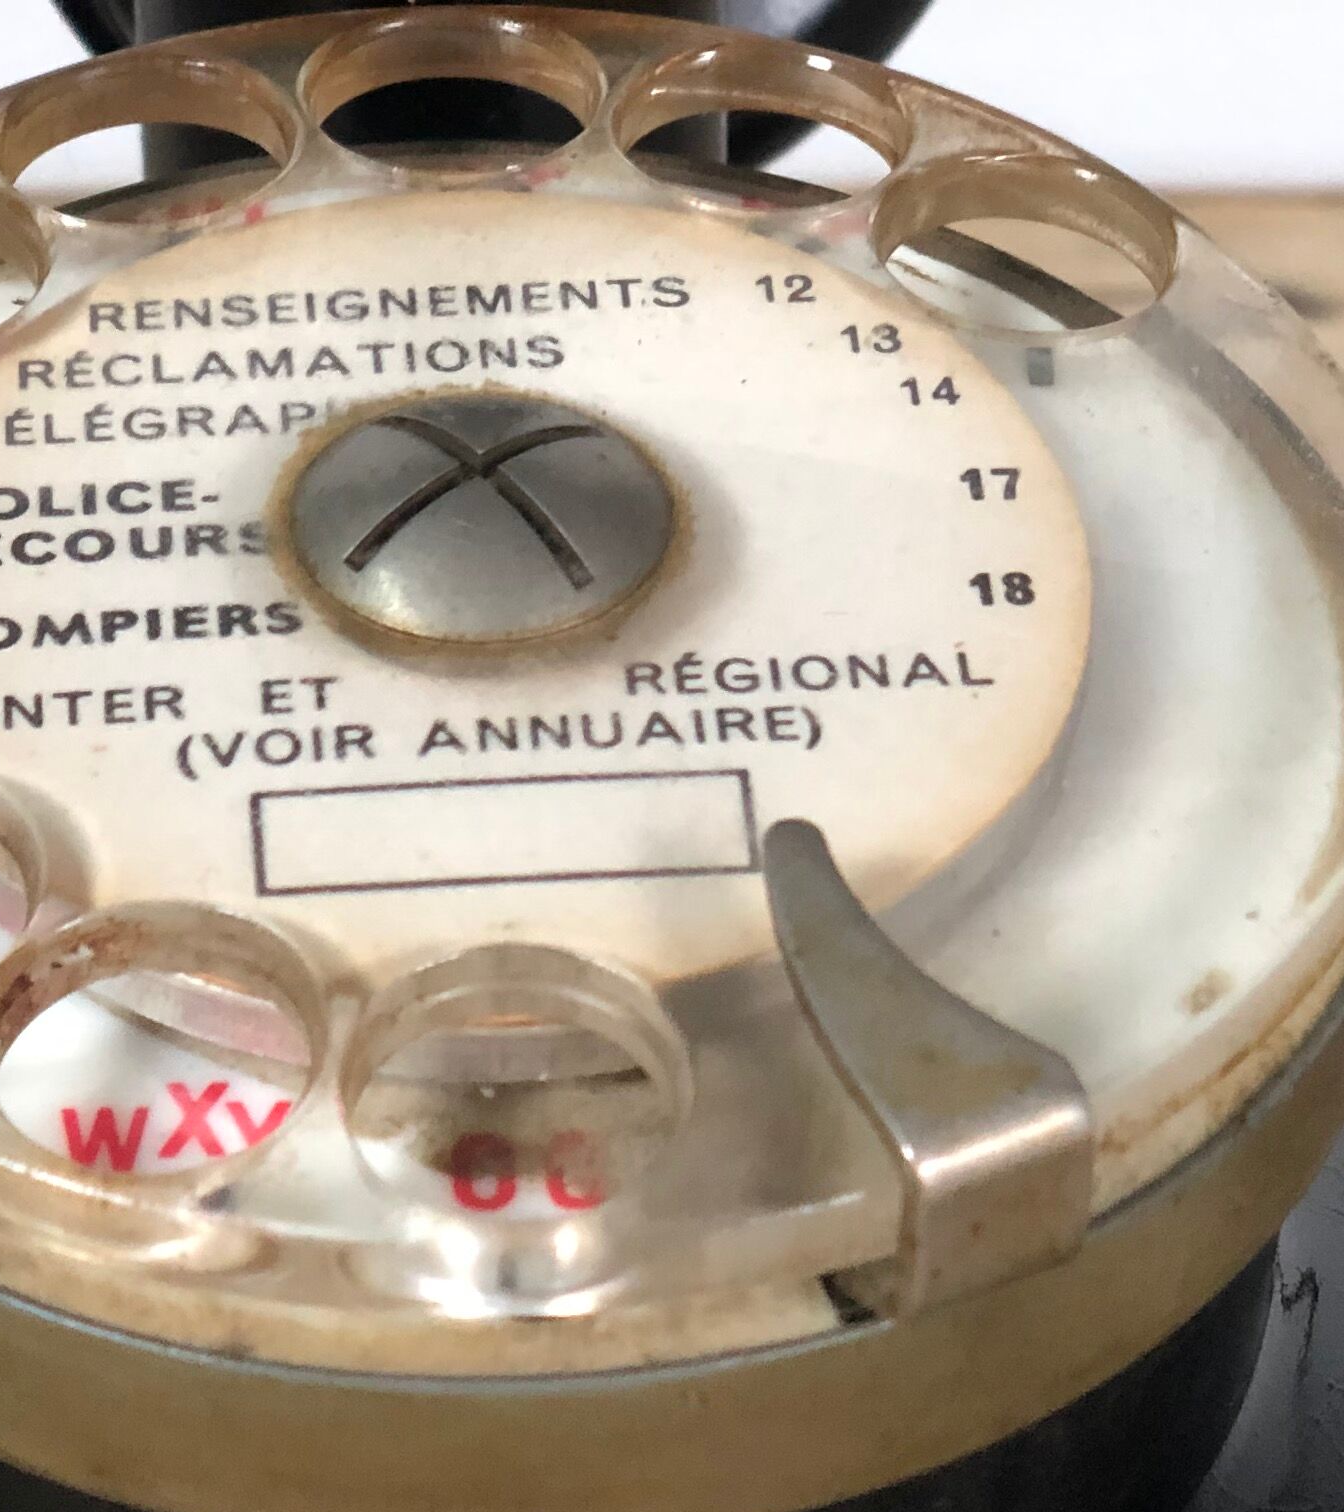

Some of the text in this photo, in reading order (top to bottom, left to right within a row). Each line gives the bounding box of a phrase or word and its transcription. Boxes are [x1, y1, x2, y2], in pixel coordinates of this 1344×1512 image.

[89, 273, 817, 334] RENSEIGNEMENTS 12
[18, 323, 903, 390] RÉCLAMATIONS 13
[900, 375, 961, 406] 14
[960, 467, 1021, 501] 17
[968, 571, 1037, 606] 18
[260, 676, 339, 715] ET
[624, 648, 997, 696] RÉGIONAL
[174, 704, 824, 781] (VOIR ANNUAIRE)
